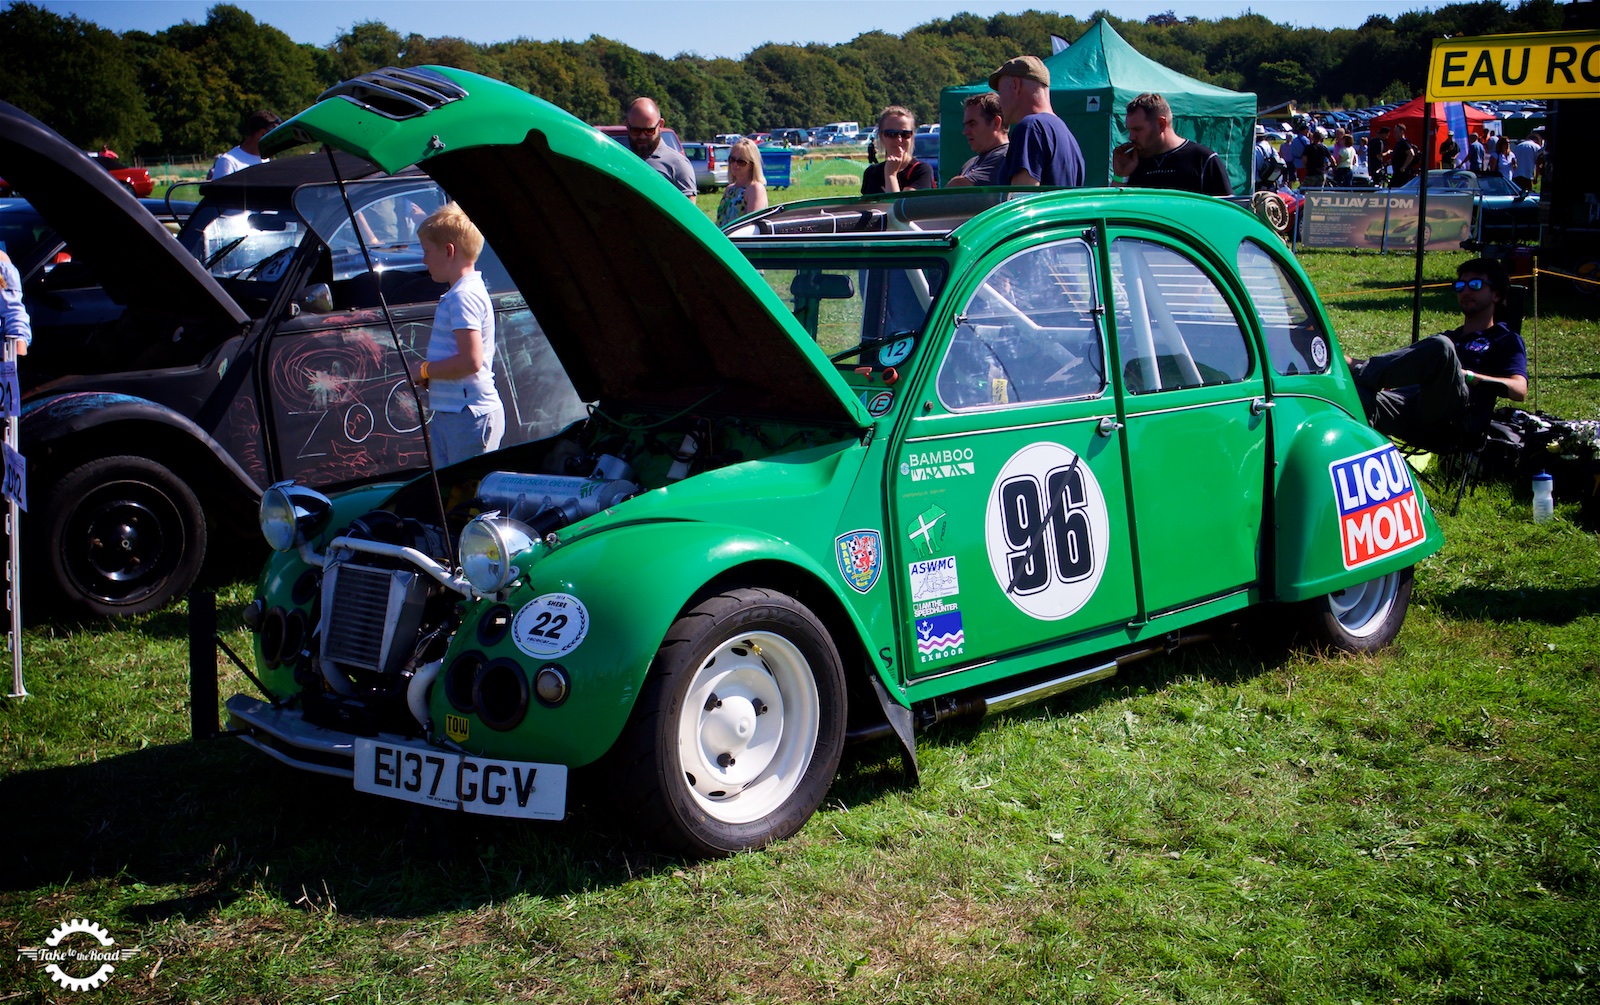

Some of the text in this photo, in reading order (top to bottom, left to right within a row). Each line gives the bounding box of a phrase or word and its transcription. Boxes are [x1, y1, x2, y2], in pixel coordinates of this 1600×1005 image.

[1441, 48, 1531, 87] EAU
[267, 260, 285, 275] 21
[886, 341, 907, 358] 12
[909, 447, 974, 467] BAMBOO
[499, 476, 581, 488] immersion eleven
[1337, 450, 1411, 510] LIQUI
[999, 465, 1096, 596] 96
[1346, 494, 1421, 561] MOLY
[840, 542, 852, 574] BARC
[911, 557, 954, 576] ASWMC
[529, 612, 568, 640] 22
[921, 648, 963, 663] EXMOOR
[448, 716, 468, 735] TOW
[374, 746, 537, 808] E137 GGV
